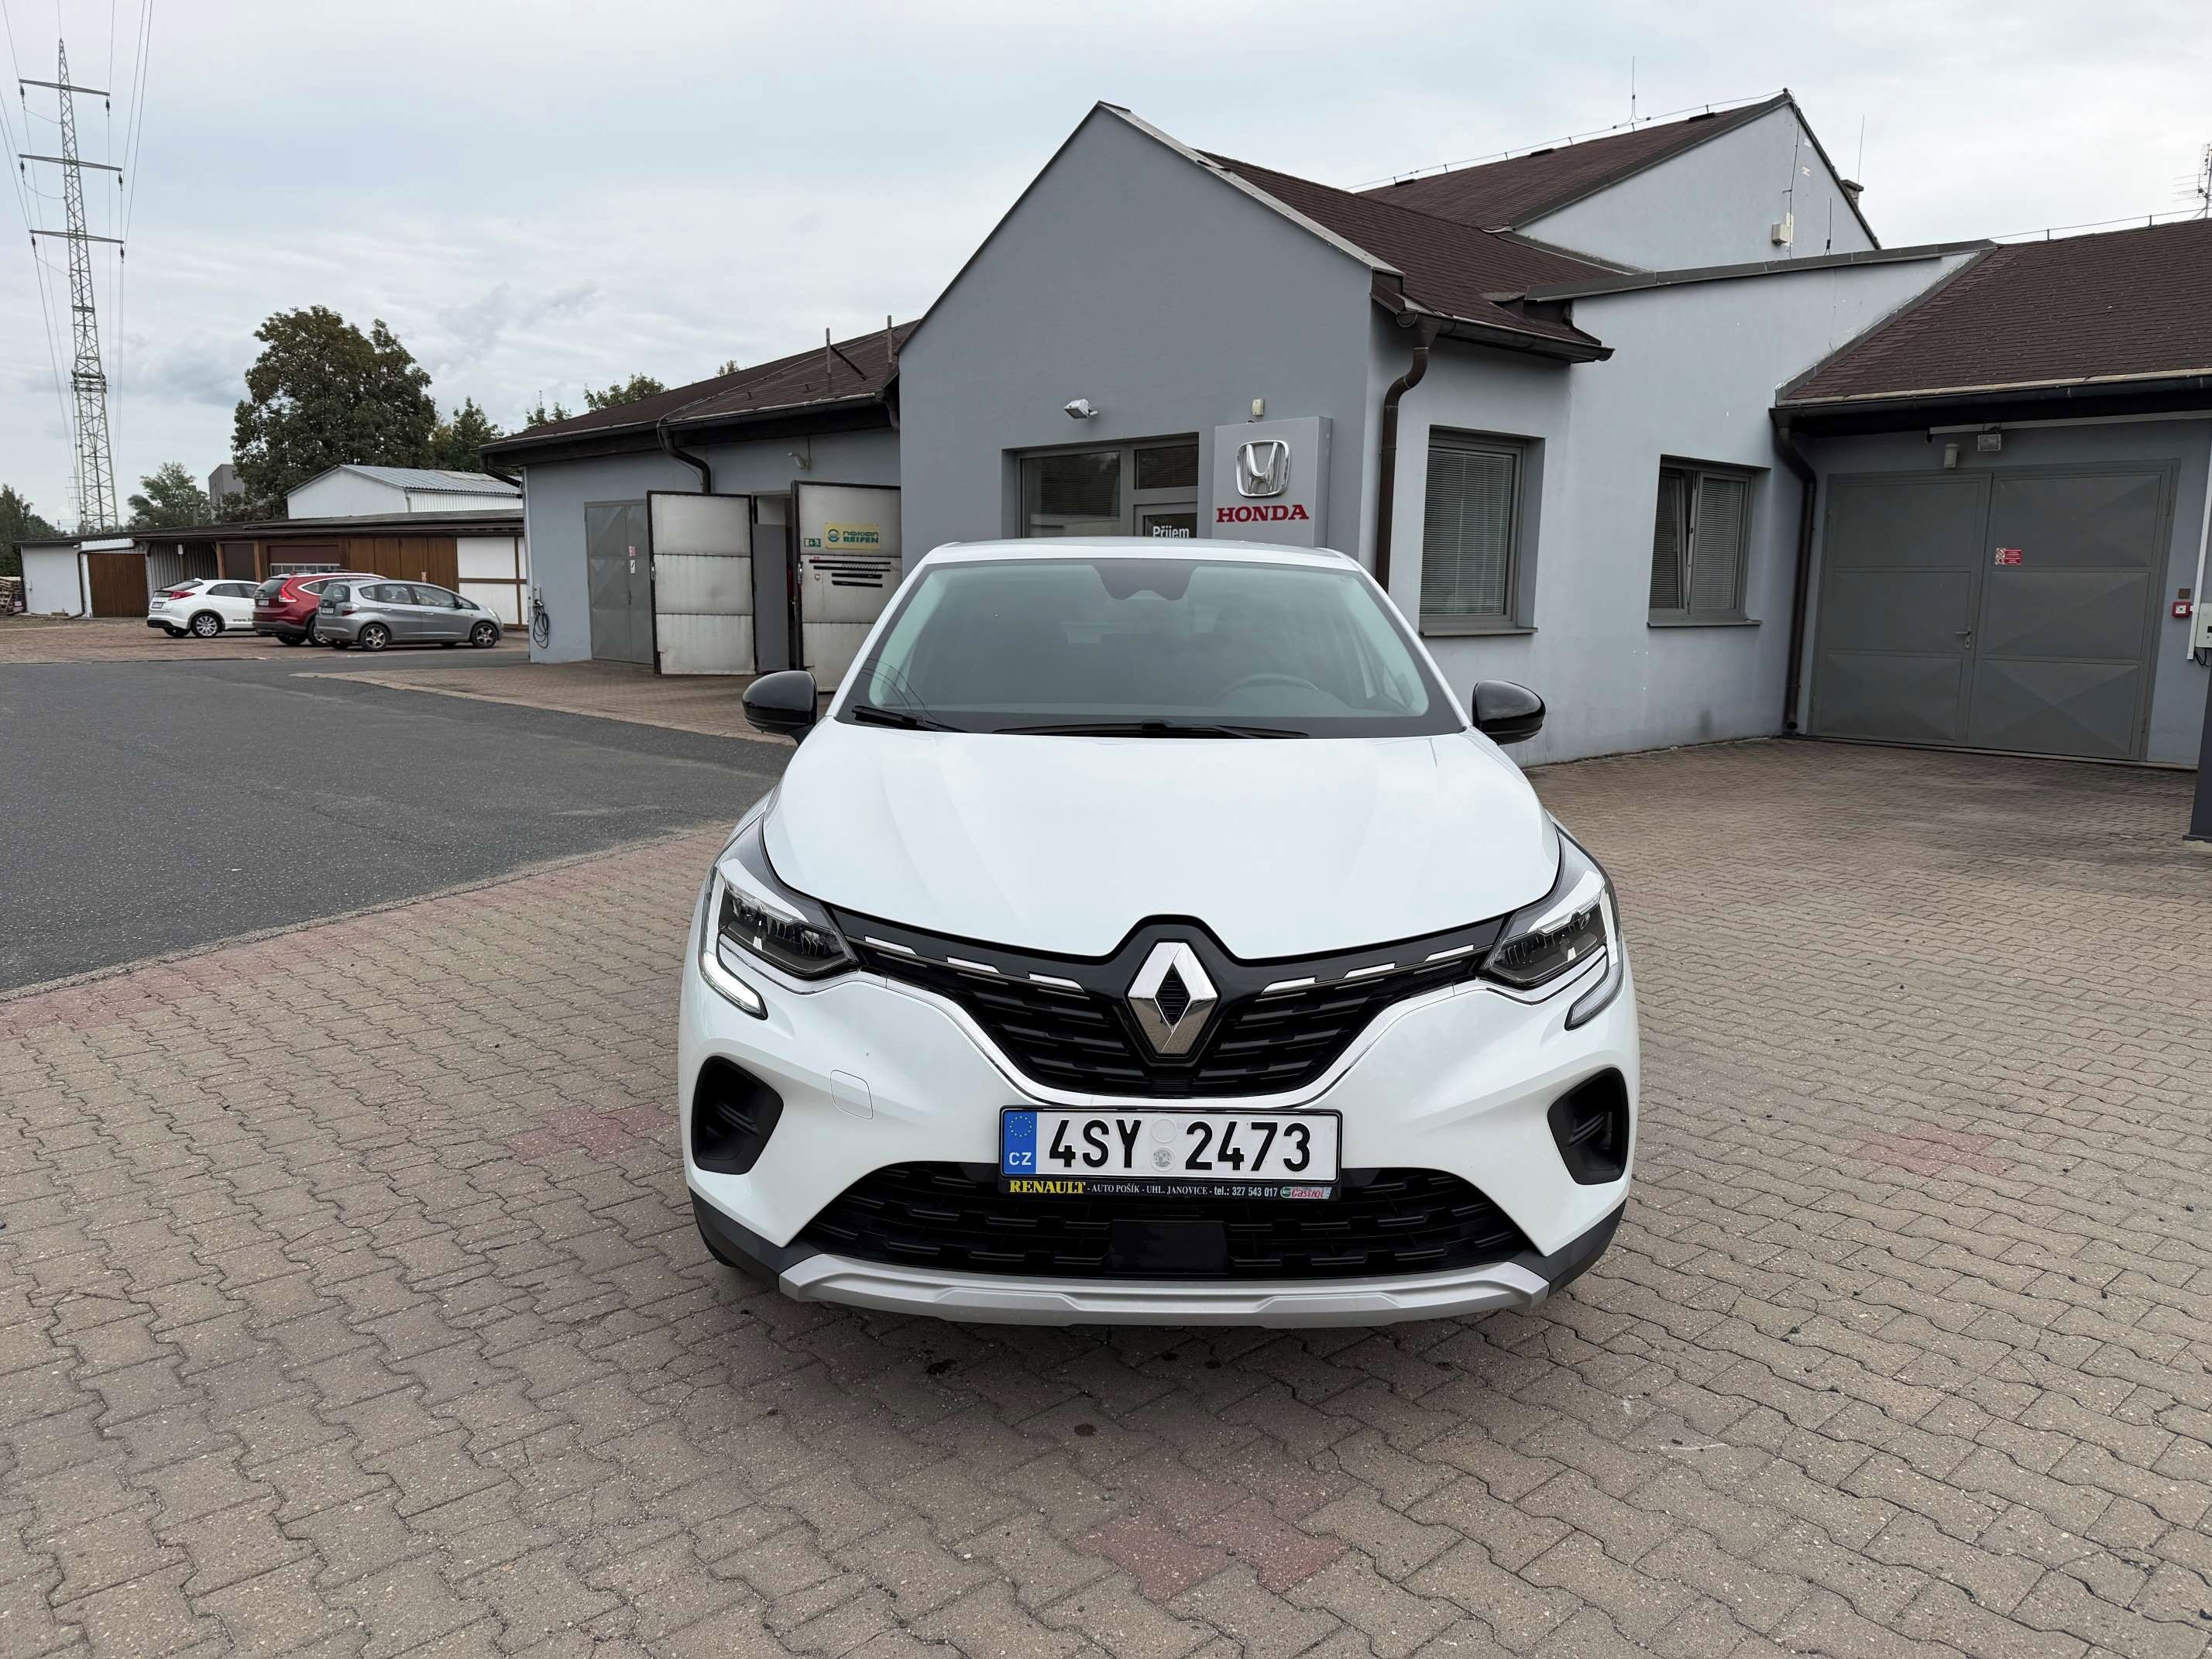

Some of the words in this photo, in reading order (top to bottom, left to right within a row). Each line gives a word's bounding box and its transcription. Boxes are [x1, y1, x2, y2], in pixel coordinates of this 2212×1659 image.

[1216, 504, 1310, 523] HONDA
[1049, 1119, 1143, 1168] 4SY
[1185, 1121, 1311, 1172] 2473
[1008, 1151, 1032, 1166] CZ
[1009, 1180, 1086, 1194] RENAULT
[1091, 1184, 1115, 1193] AUTO
[1116, 1183, 1140, 1194] POŠÍK
[1166, 1186, 1208, 1195] JANOVICE
[1214, 1187, 1230, 1196] tel.:
[1231, 1187, 1245, 1197] 327
[1248, 1187, 1262, 1197] 543
[1264, 1187, 1278, 1197] 017
